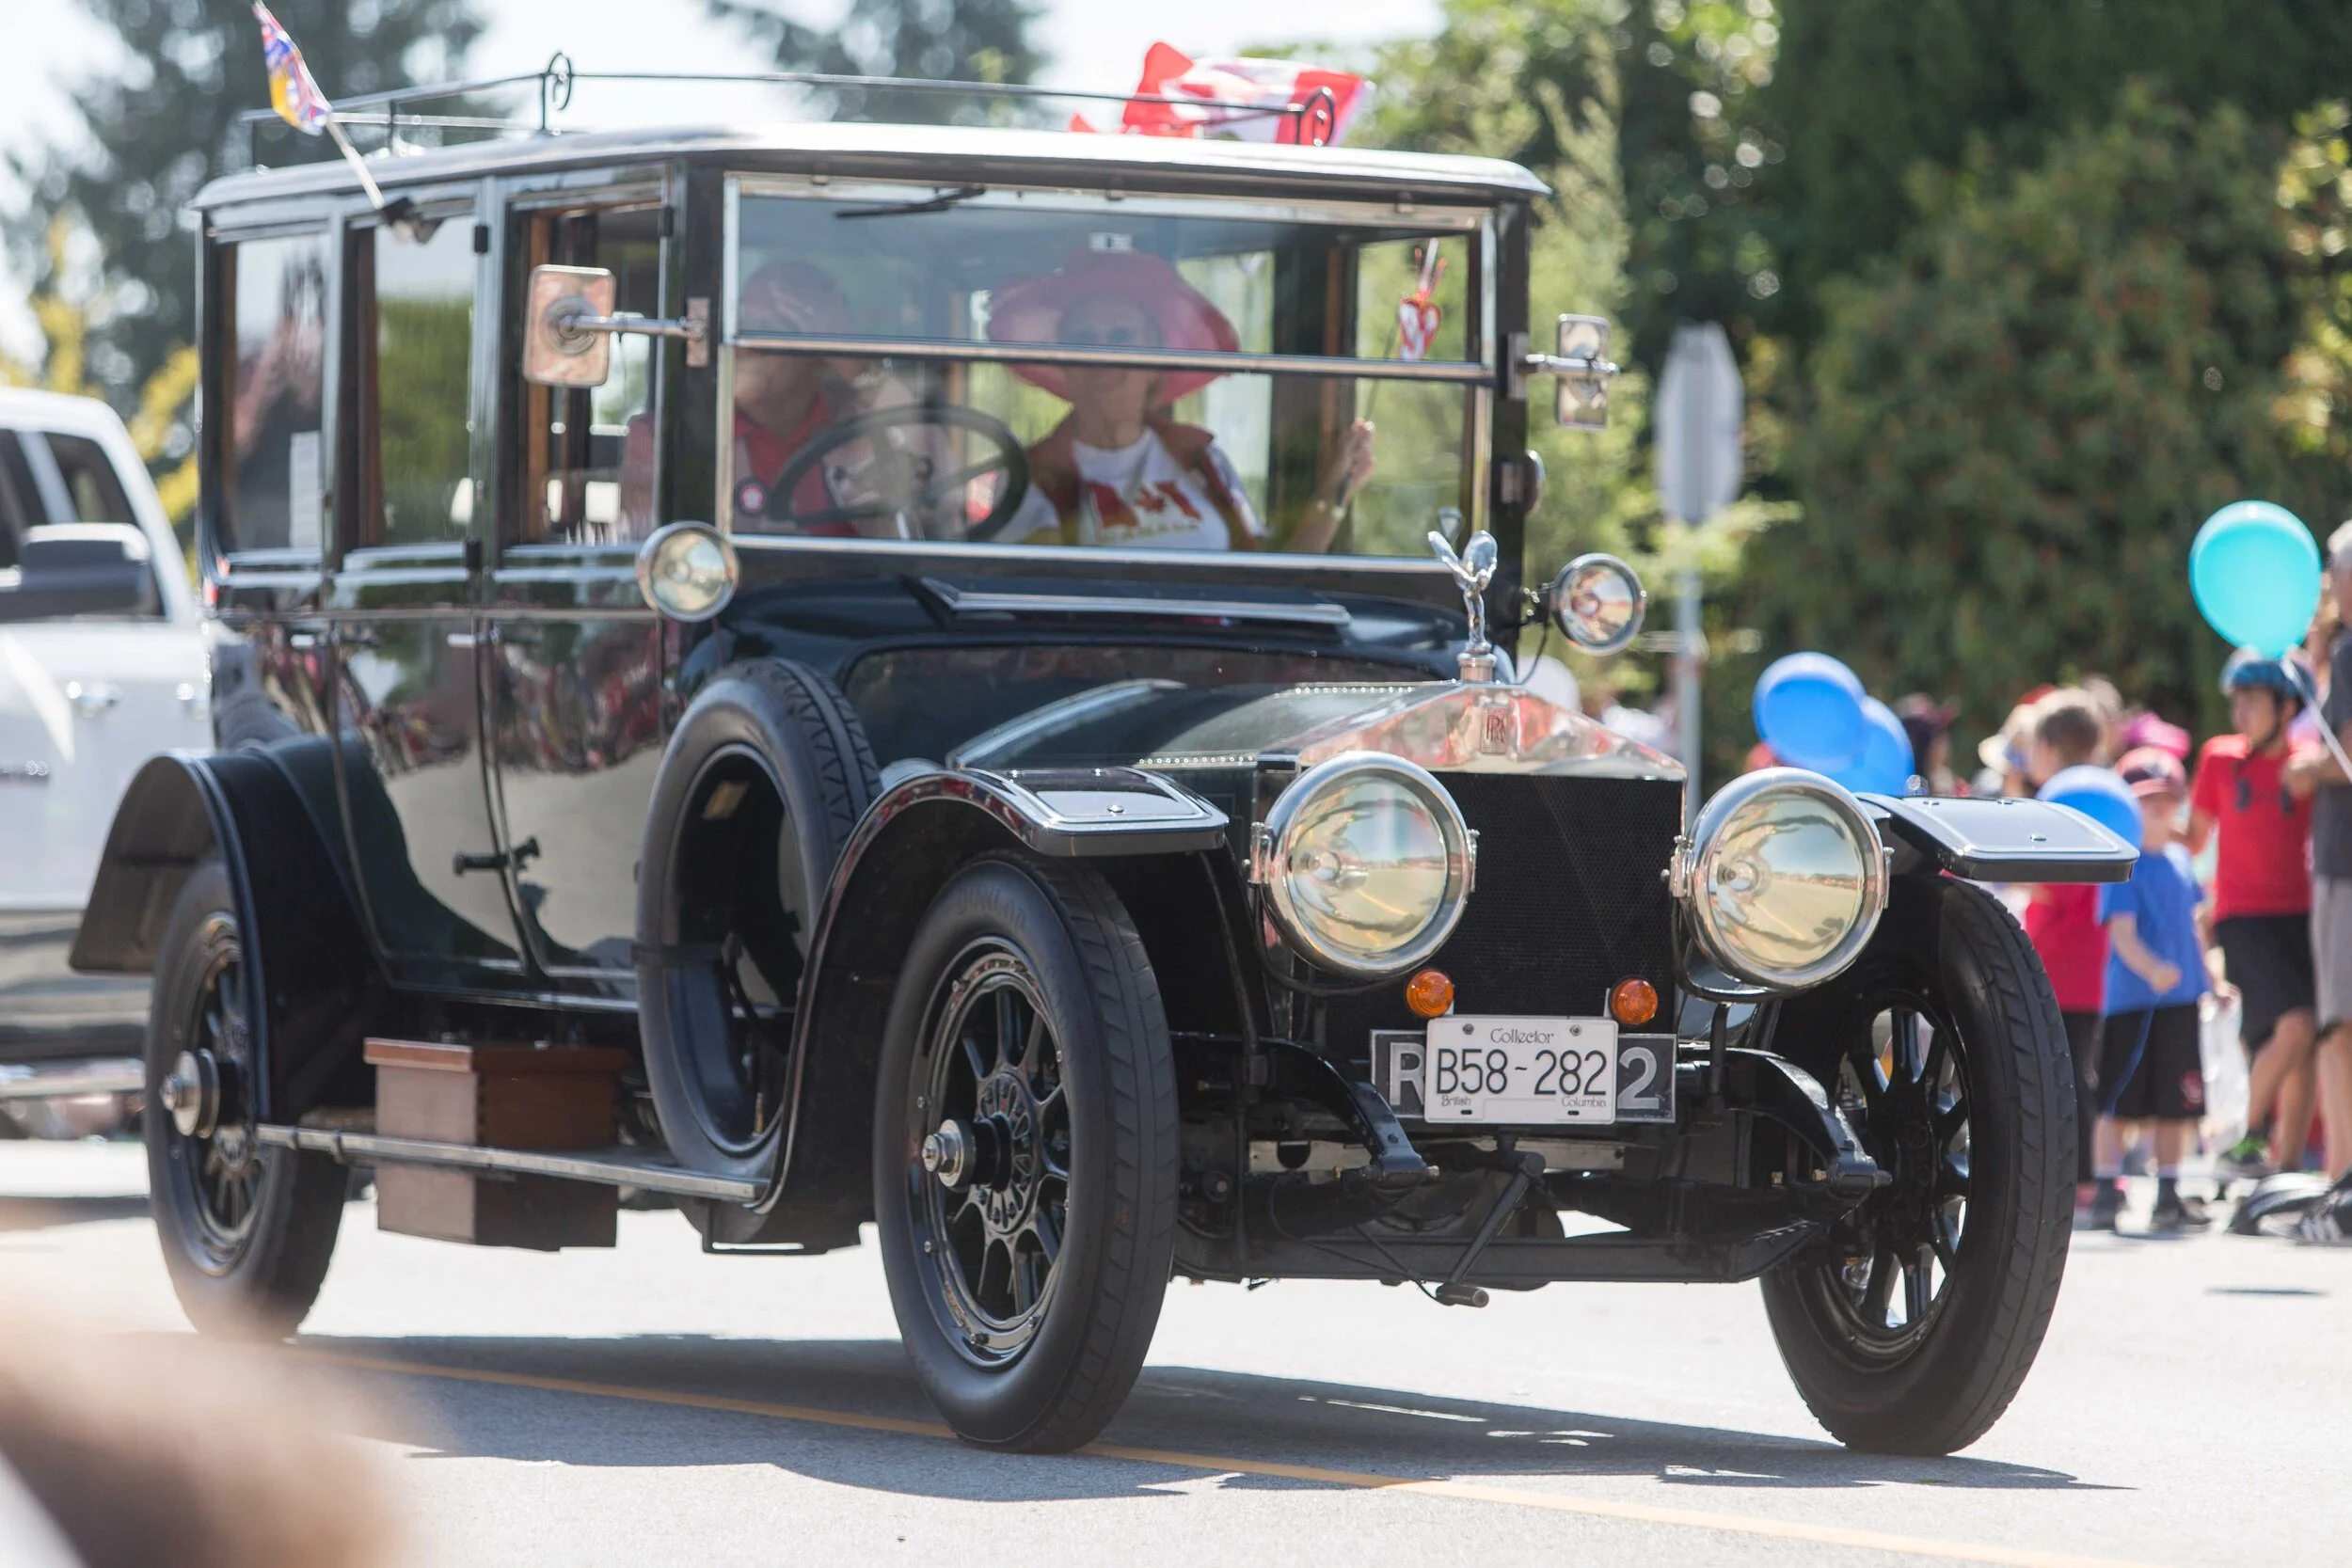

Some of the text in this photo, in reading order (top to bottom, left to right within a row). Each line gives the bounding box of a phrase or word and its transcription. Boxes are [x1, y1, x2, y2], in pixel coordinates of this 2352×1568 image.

[1490, 1028, 1555, 1045] Collector
[1437, 1048, 1607, 1096] B58-282
[1440, 1094, 1607, 1108] British Columbia
